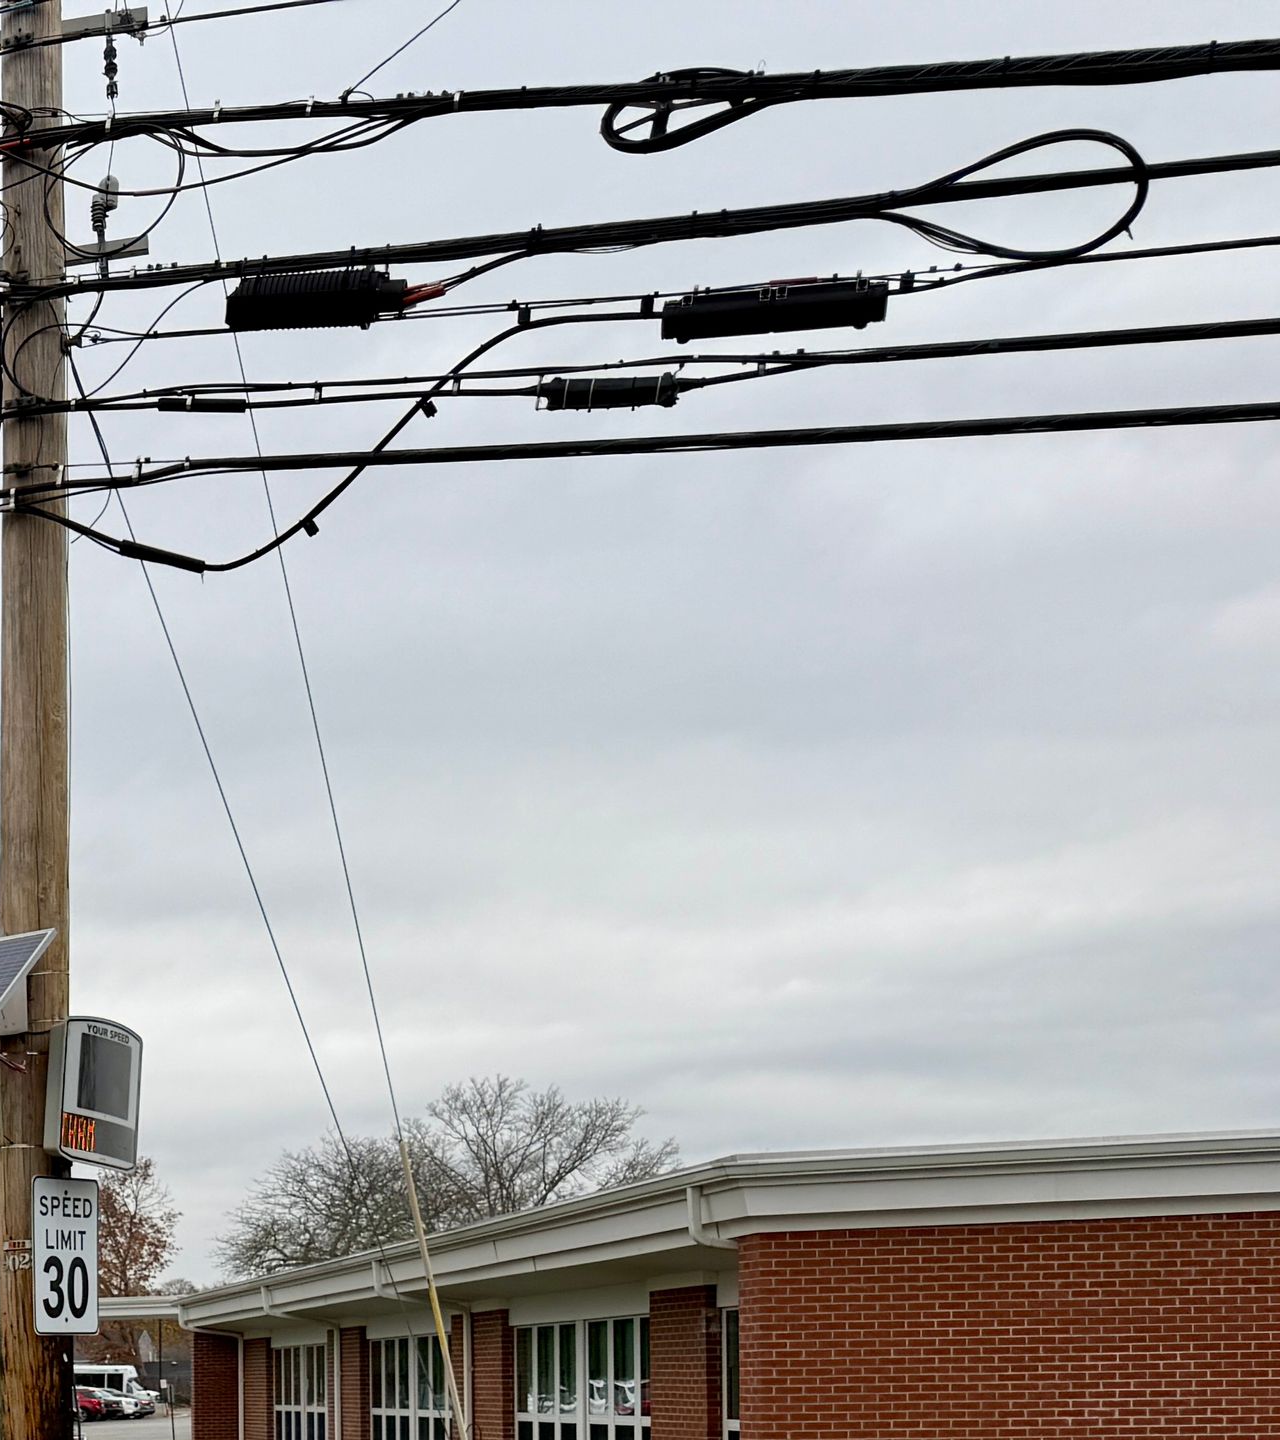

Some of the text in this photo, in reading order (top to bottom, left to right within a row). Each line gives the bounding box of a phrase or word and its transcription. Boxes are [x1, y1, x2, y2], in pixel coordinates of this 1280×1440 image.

[87, 1023, 130, 1044] YOUR SPEED
[40, 1195, 93, 1218] SPEED
[46, 1228, 87, 1251] LIMIT
[43, 1256, 89, 1319] 30
